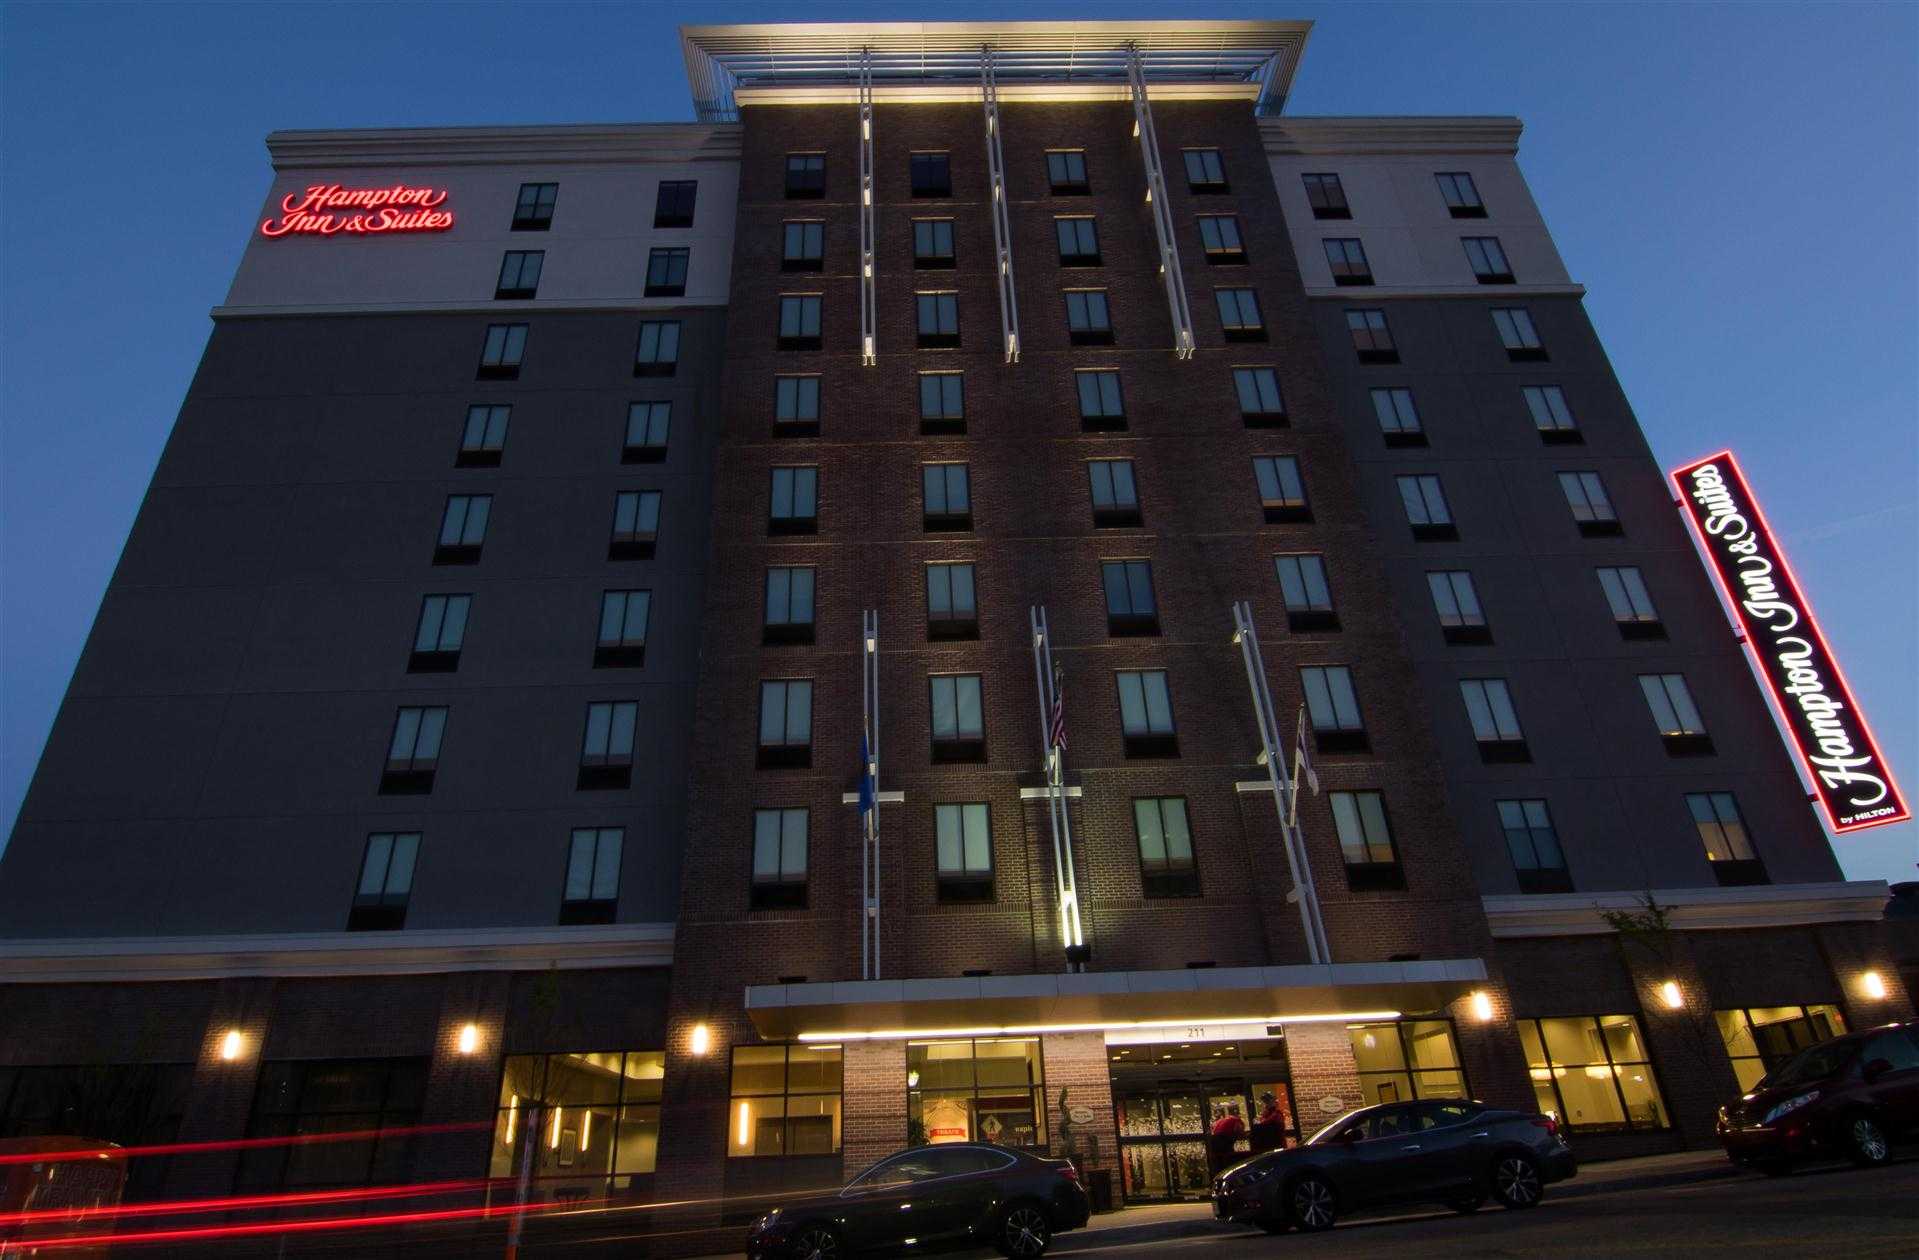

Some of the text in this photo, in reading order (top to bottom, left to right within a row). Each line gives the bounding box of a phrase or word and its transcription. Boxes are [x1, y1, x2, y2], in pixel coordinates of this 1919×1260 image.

[283, 184, 447, 212] Hampton
[262, 208, 452, 236] Inn & Suites
[1692, 463, 1887, 806] Hampton Inn & Suites
[1840, 806, 1896, 824] by HILTON
[1187, 1027, 1204, 1038] 211
